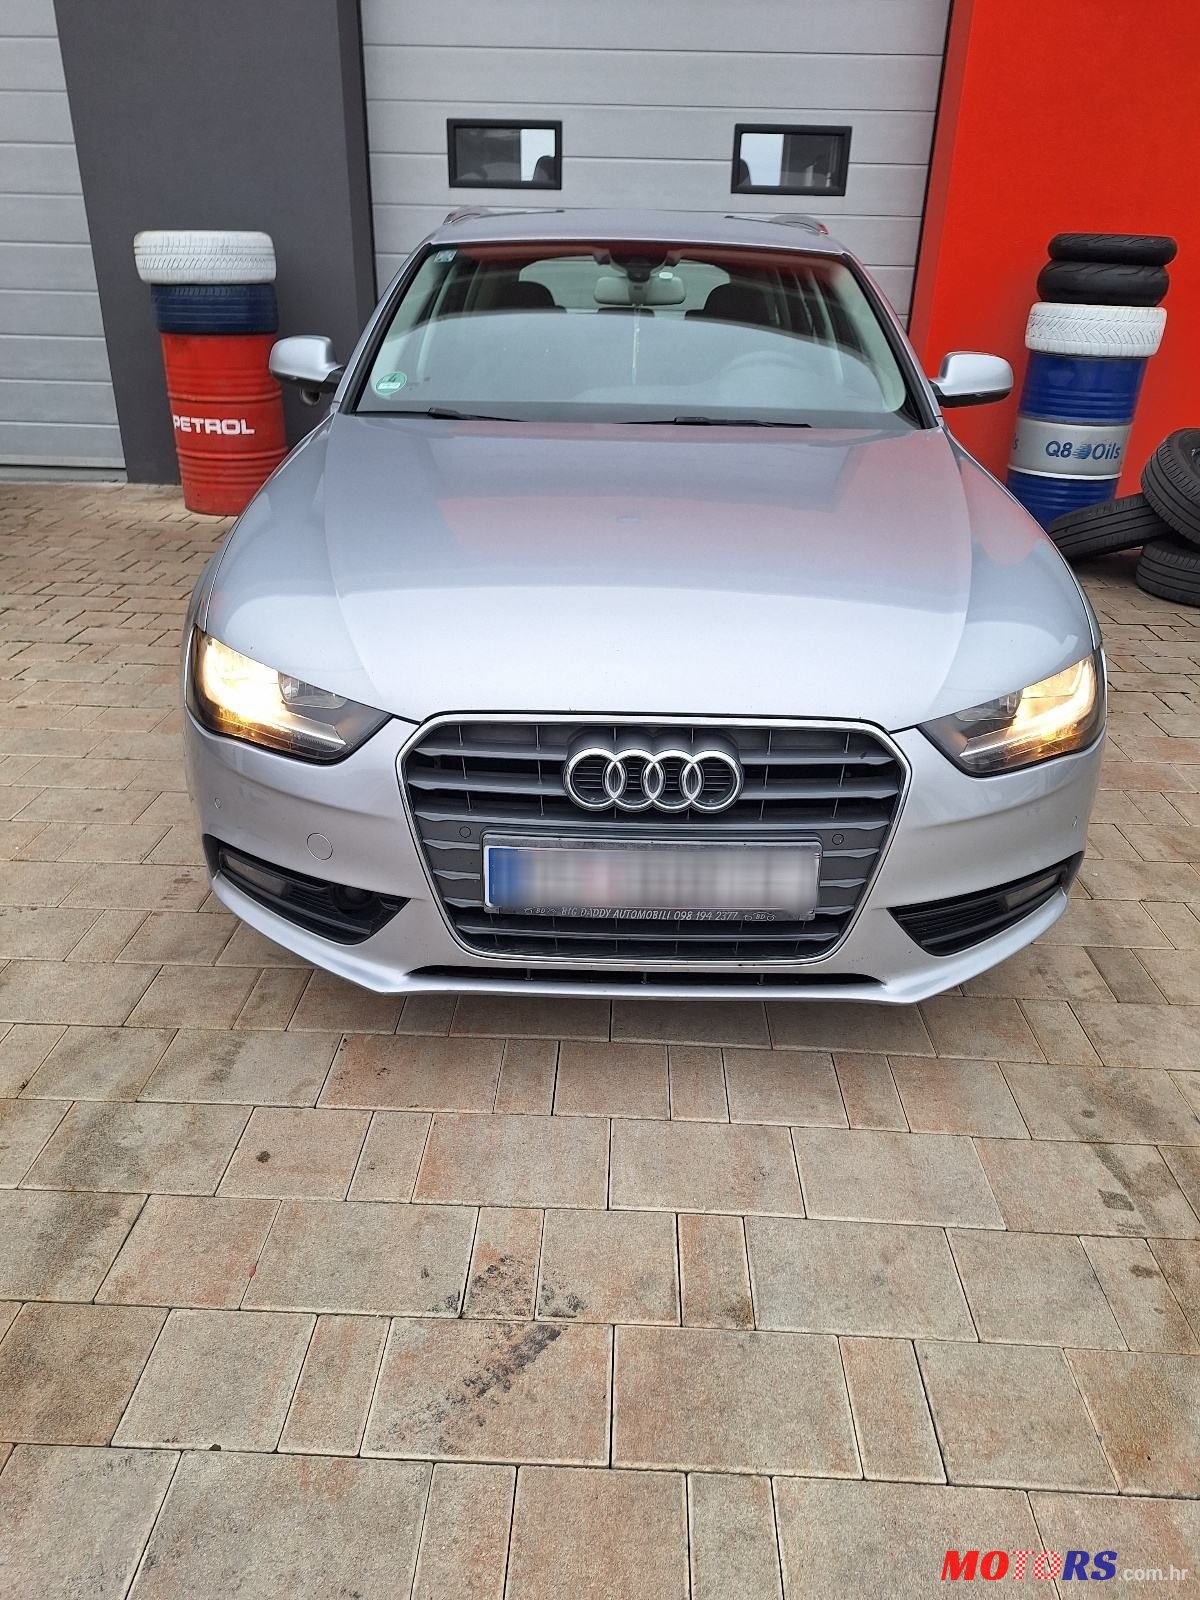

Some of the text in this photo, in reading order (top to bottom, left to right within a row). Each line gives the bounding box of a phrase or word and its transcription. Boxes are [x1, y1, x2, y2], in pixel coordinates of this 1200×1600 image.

[172, 414, 255, 435] PETROL
[1045, 440, 1120, 460] Q8 Oils
[561, 906, 579, 916] BIG
[580, 907, 612, 918] DADDY
[612, 909, 671, 920] AUTOMOBILI
[695, 911, 713, 920] 194
[715, 911, 739, 921] 2377
